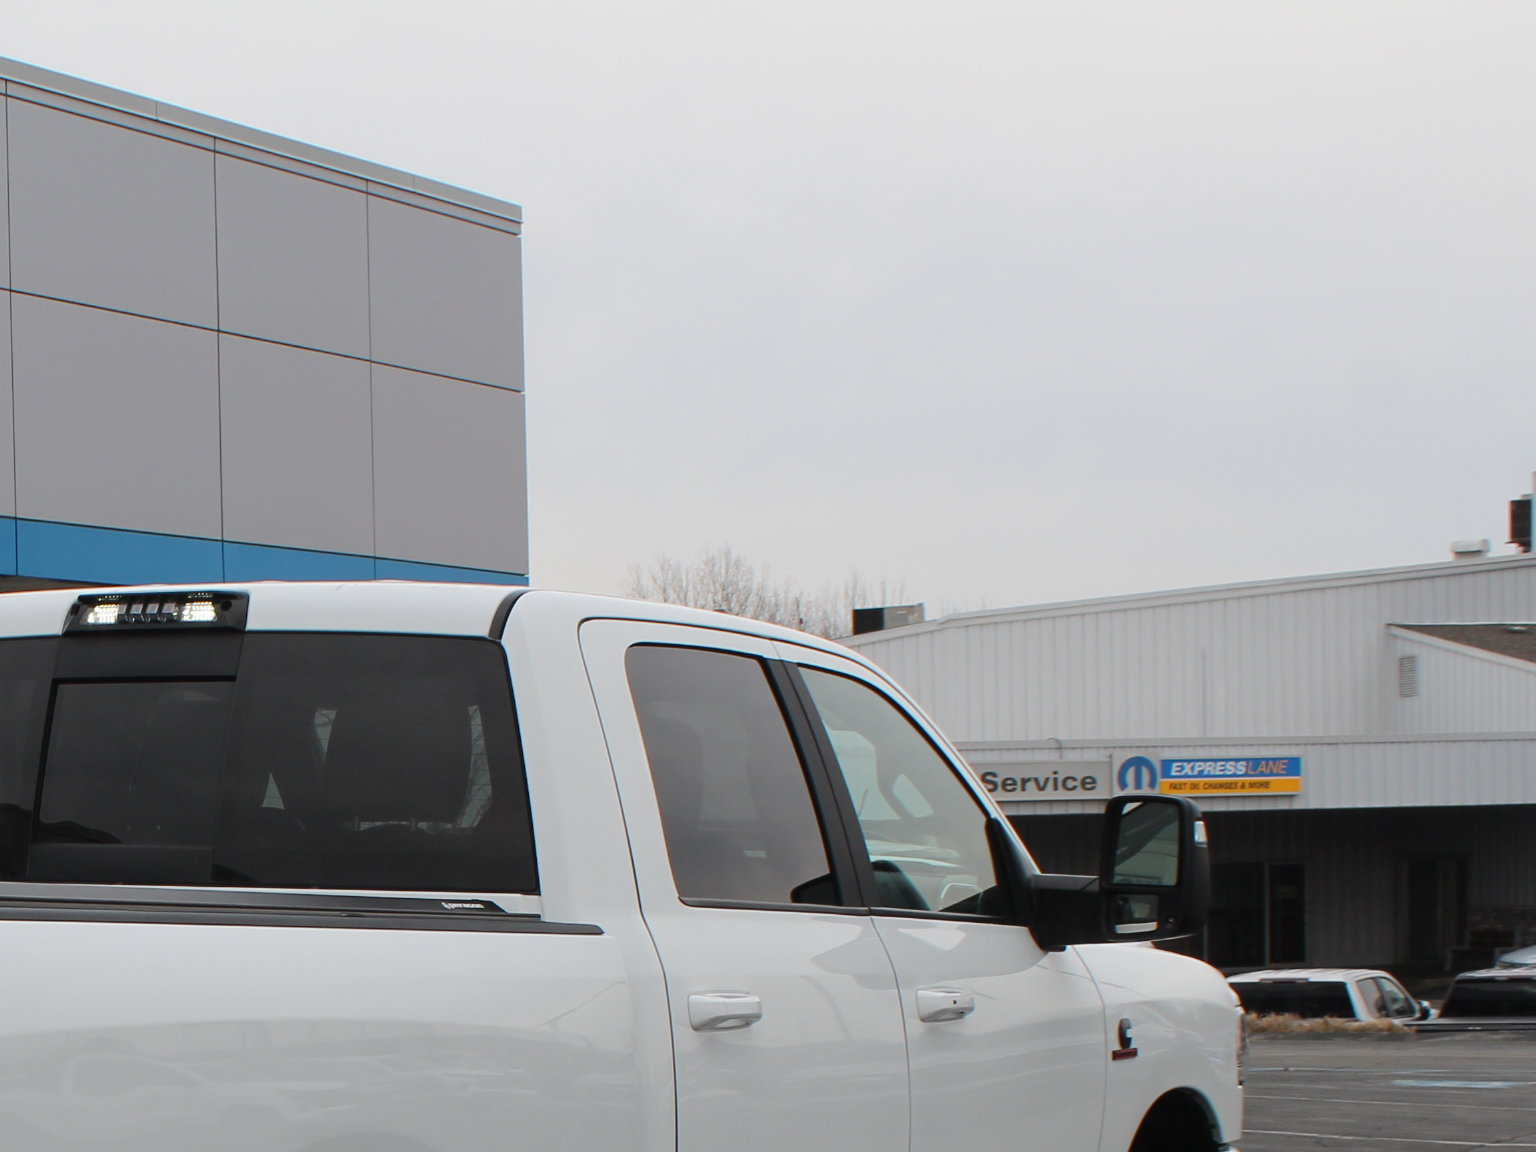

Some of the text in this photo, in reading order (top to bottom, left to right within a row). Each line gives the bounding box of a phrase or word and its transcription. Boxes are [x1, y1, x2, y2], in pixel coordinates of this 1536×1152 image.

[980, 770, 1097, 793] Service
[1168, 782, 1187, 791] FAST
[1189, 782, 1201, 790] OIL
[1203, 781, 1238, 790] CHANGES
[1248, 780, 1271, 789] MORE
